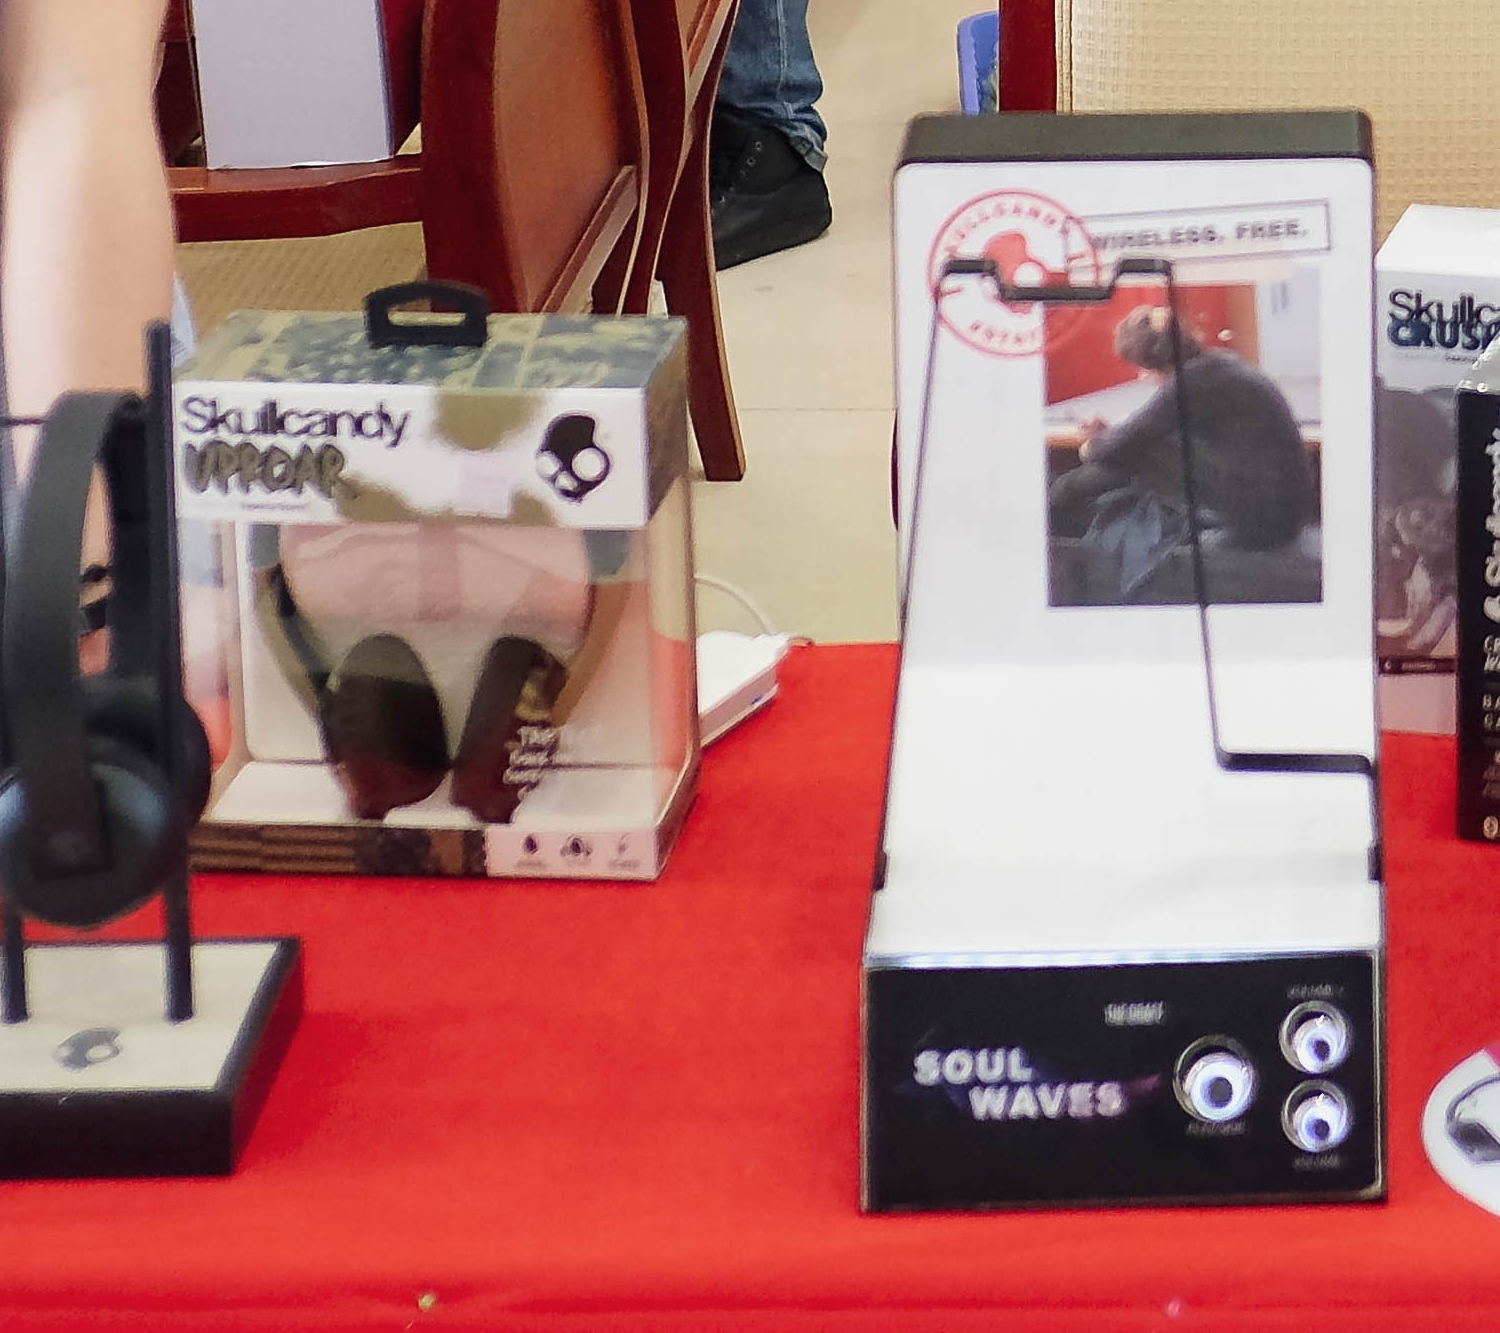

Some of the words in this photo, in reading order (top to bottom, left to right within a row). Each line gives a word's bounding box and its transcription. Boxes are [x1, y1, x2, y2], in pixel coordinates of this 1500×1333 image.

[184, 396, 412, 450] Skullcandy
[913, 1046, 1034, 1085] SOUL
[967, 1081, 1129, 1121] WAVES
